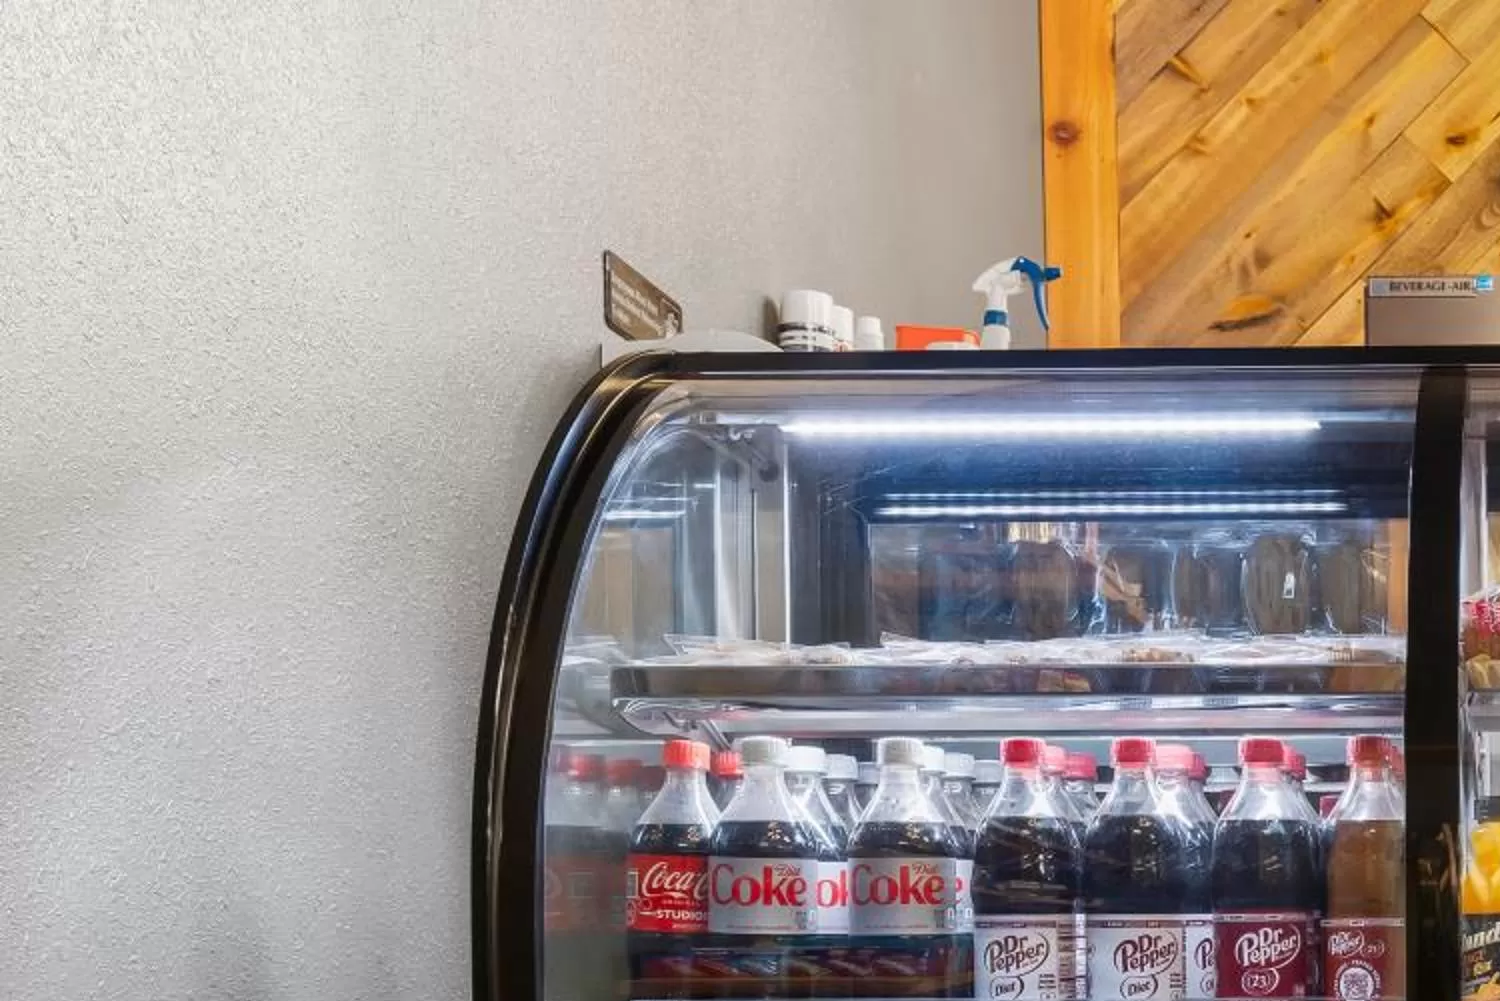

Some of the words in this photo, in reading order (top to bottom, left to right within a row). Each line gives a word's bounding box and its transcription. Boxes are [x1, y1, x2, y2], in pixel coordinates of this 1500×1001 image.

[711, 863, 808, 907] Coke
[852, 863, 946, 906] Coke
[1003, 935, 1028, 954] Dr
[1138, 934, 1163, 953] Dr
[1235, 932, 1298, 967] Pepper
[1258, 927, 1284, 945] Dr
[984, 939, 1046, 974] Pepper
[1114, 939, 1175, 973] Pepper
